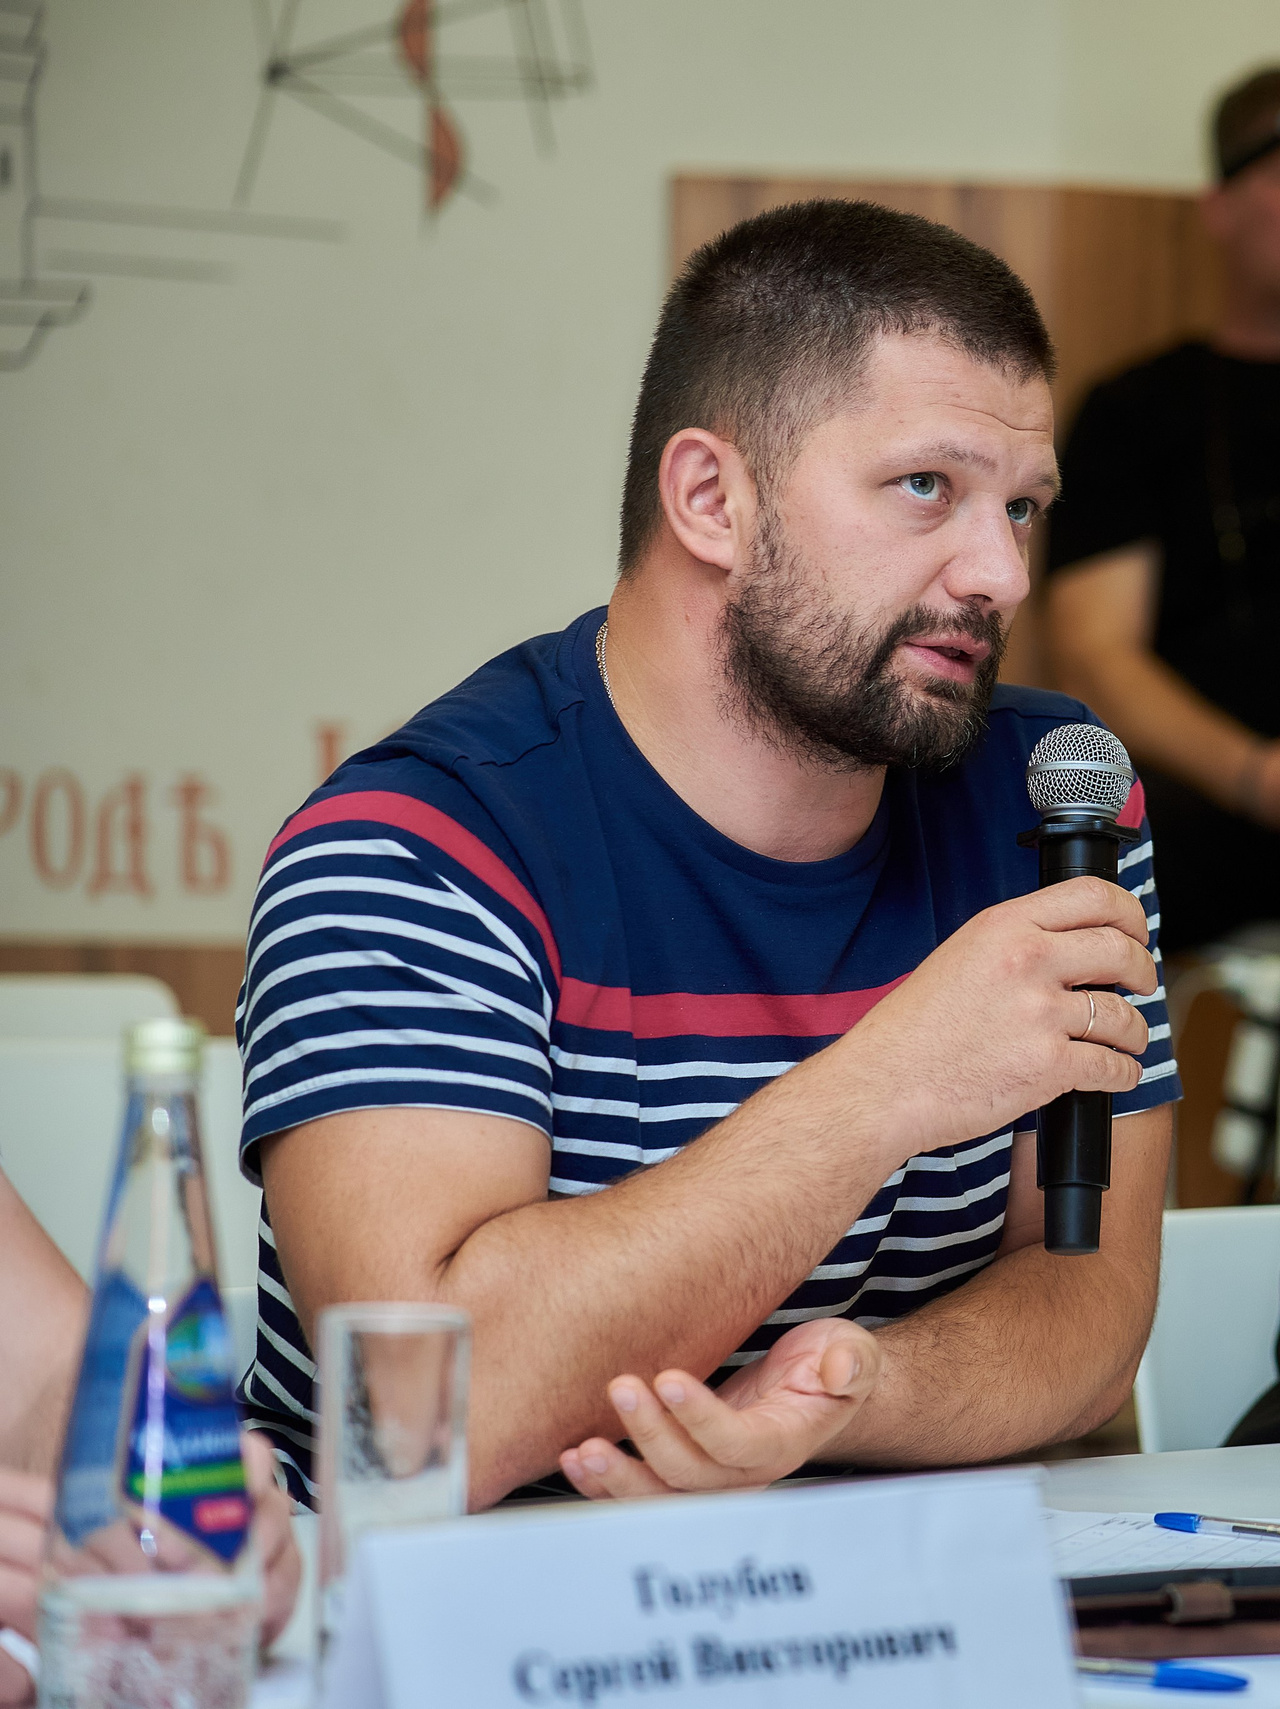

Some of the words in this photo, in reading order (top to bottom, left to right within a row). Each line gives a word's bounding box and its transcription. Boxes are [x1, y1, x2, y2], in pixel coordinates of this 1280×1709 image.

[634, 1557, 812, 1614] Голубев
[513, 1644, 681, 1703] Сергей
[690, 1622, 957, 1680] Викторович
